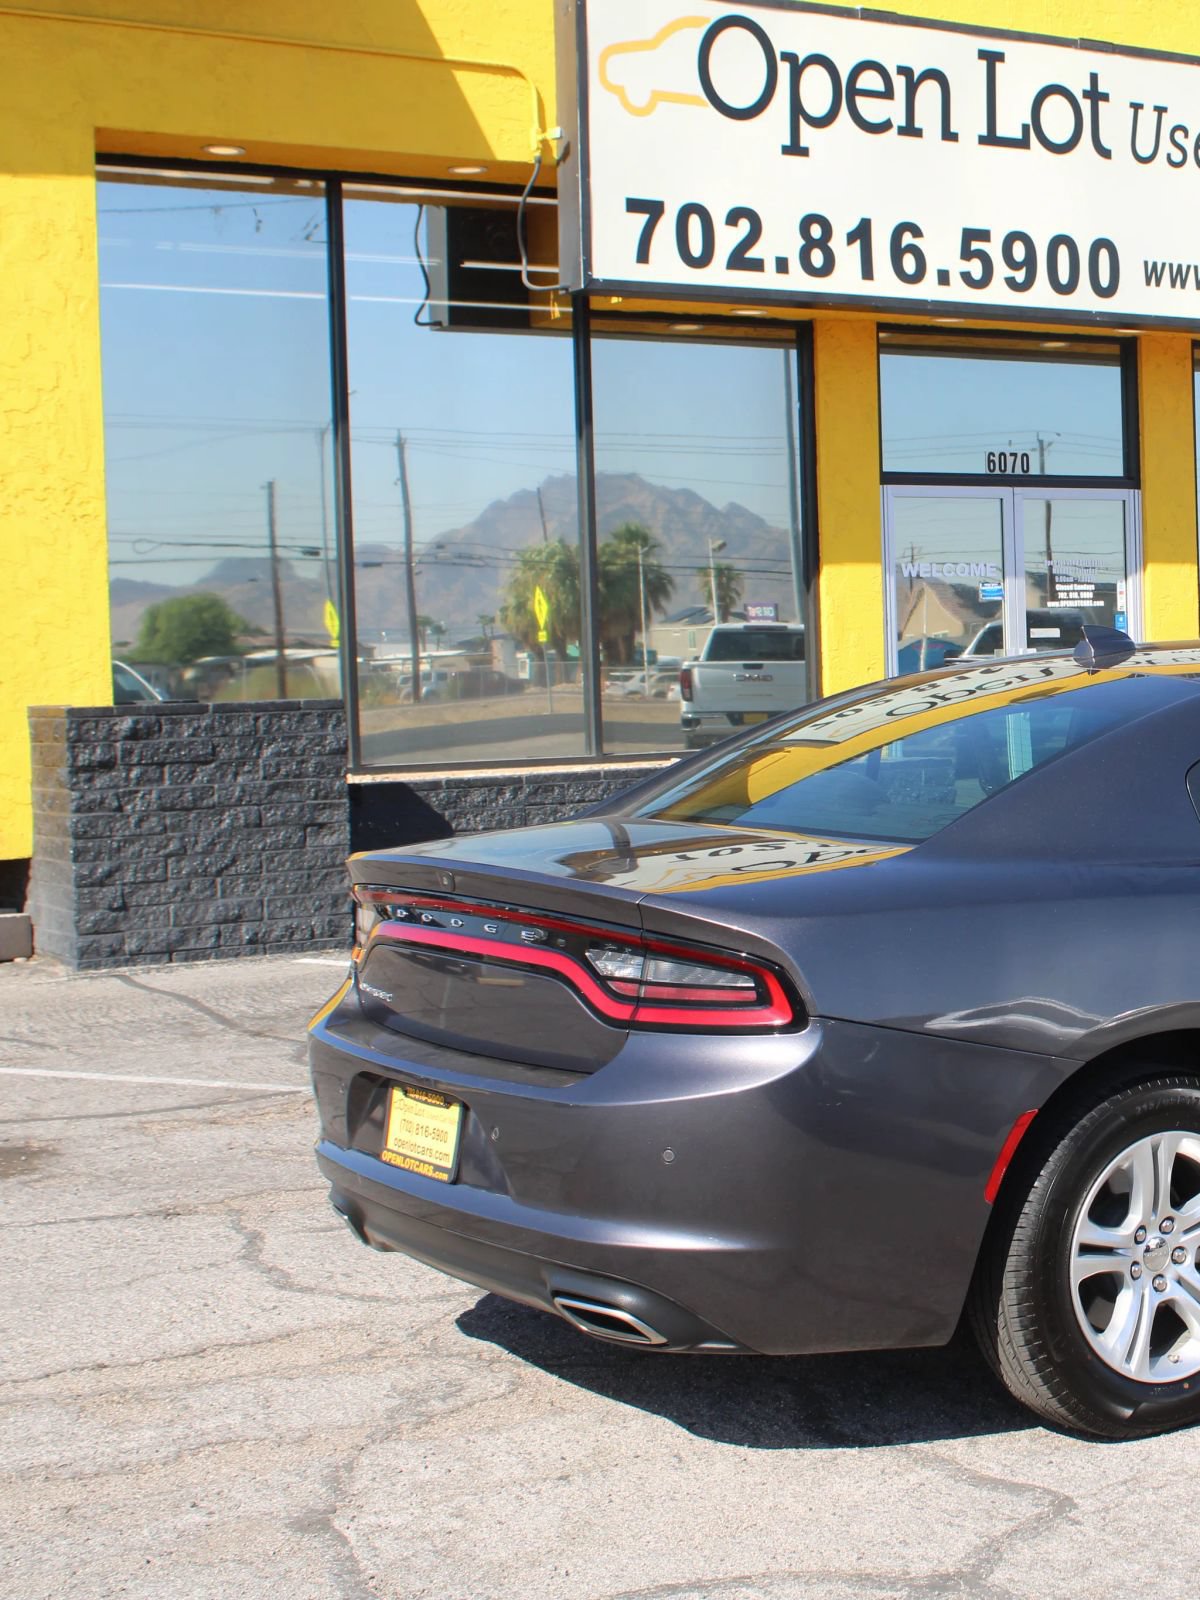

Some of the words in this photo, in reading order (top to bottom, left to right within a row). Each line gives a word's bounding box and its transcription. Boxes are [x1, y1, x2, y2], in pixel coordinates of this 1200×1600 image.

[698, 14, 959, 157] Open
[977, 49, 1112, 160] Lot
[625, 197, 1121, 298] 702.816.5900
[986, 452, 1030, 474] 6070
[901, 562, 997, 578] WELCOME
[396, 909, 535, 942] DODGE
[415, 1124, 448, 1143] 816-5900
[394, 1137, 450, 1163] openlotcars.com
[382, 1151, 449, 1181] OPENLOTCARS.com
